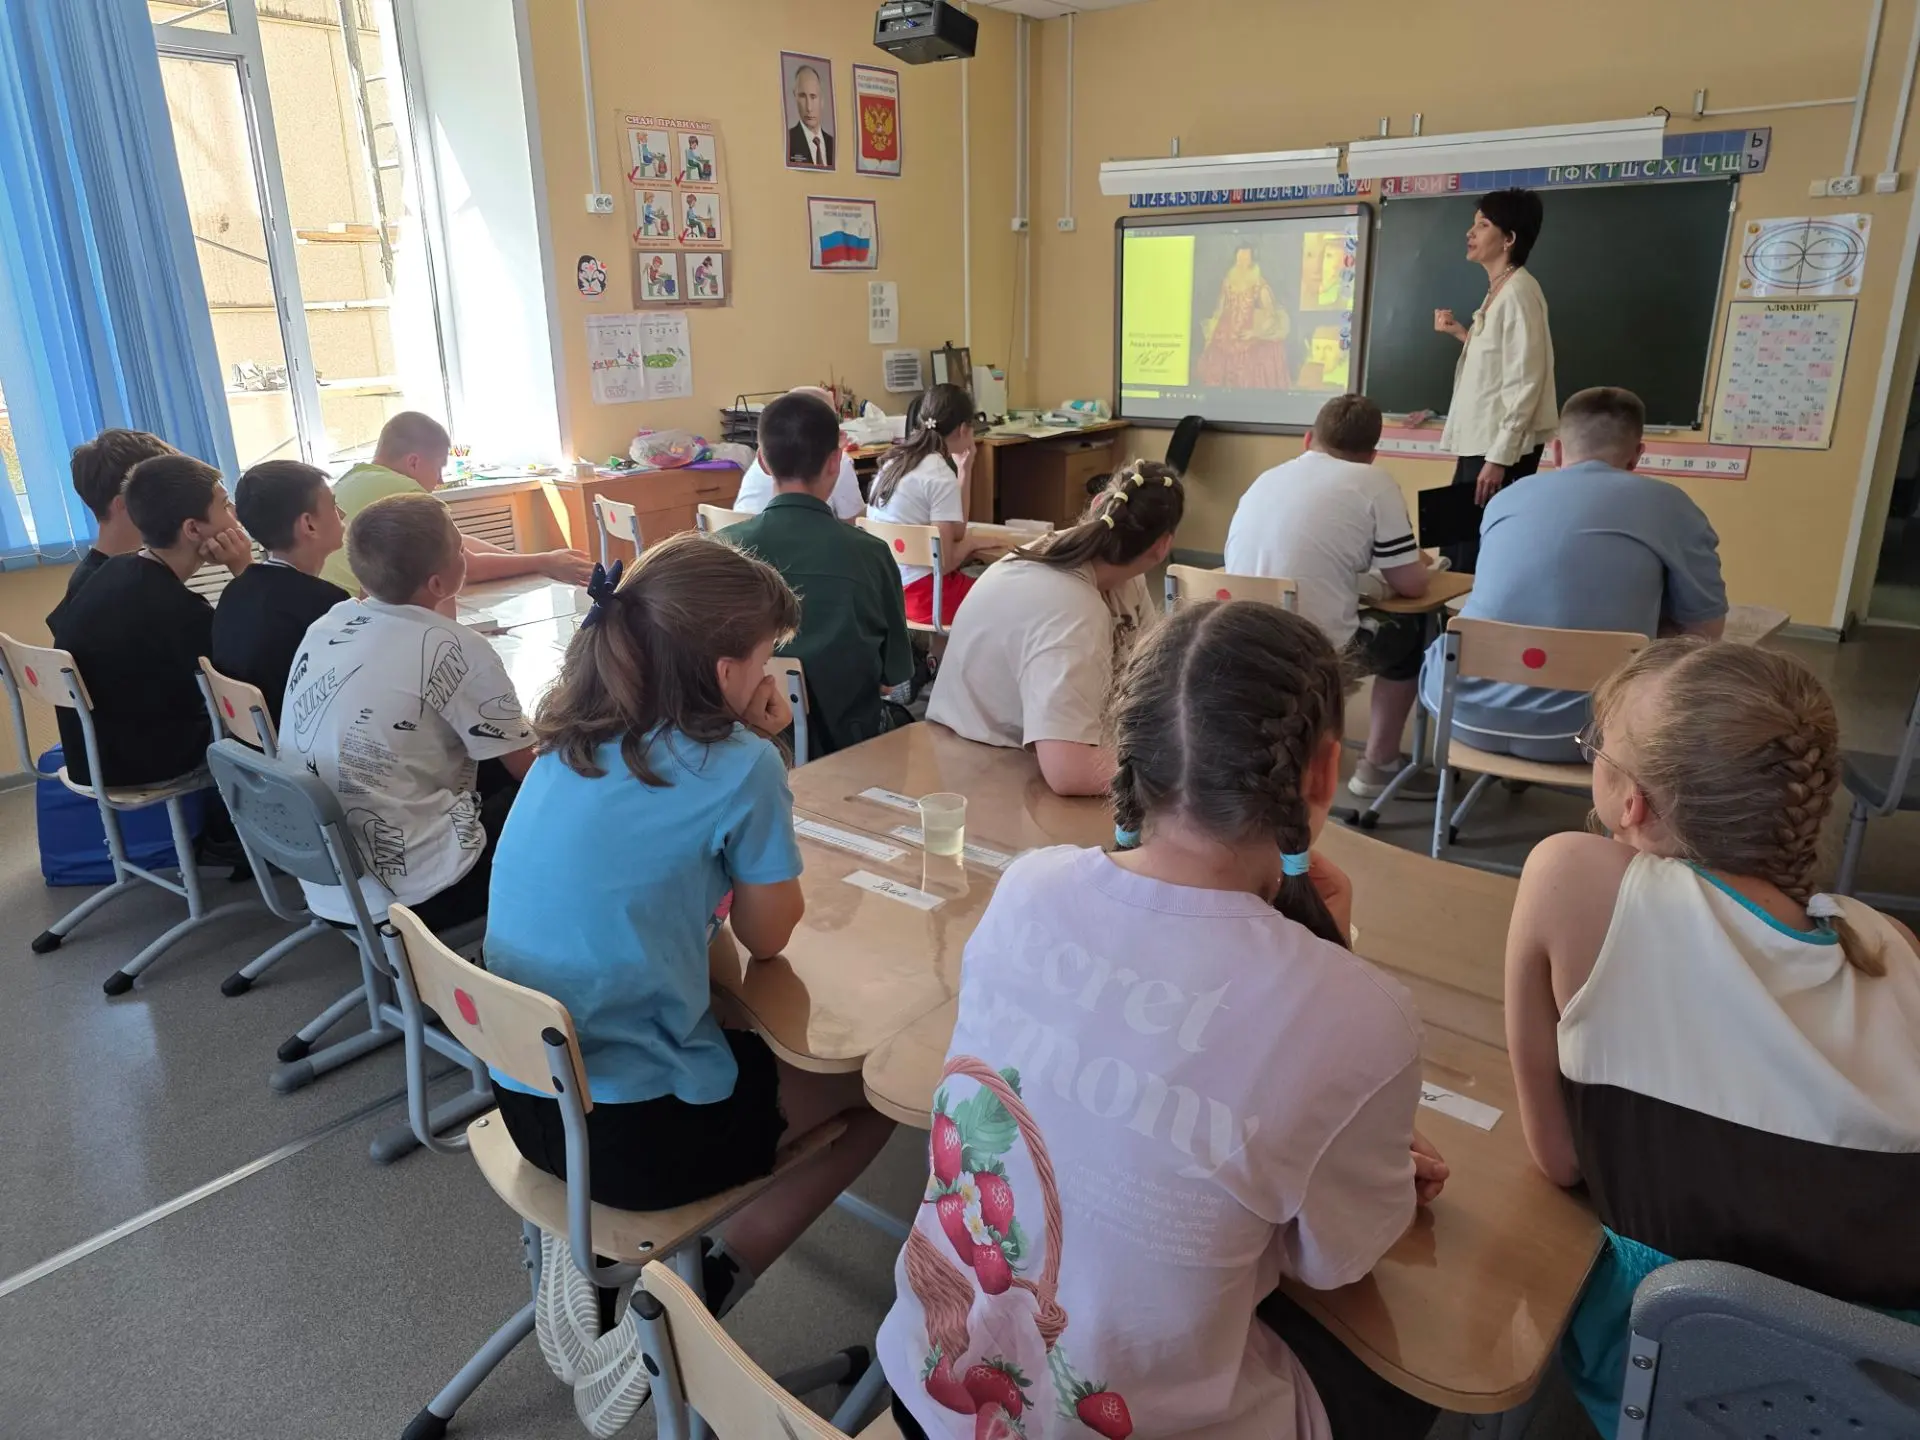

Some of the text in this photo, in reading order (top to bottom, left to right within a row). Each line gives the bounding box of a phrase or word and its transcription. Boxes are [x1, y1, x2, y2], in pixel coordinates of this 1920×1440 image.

[1548, 154, 1741, 181] П Ф К Т Ш С Х Ц Ч Щ
[1386, 178, 1395, 192] Я
[1764, 304, 1818, 312] АЛФАВИТ
[1662, 458, 1672, 466] 17
[1684, 459, 1694, 468] 18
[1706, 460, 1717, 469] 19
[1728, 461, 1740, 470] 20
[425, 645, 469, 712] NIKE
[292, 667, 337, 730] NIKE
[481, 723, 506, 738] NIKE
[374, 821, 407, 876] NIKE
[1012, 919, 1233, 1054] ecret
